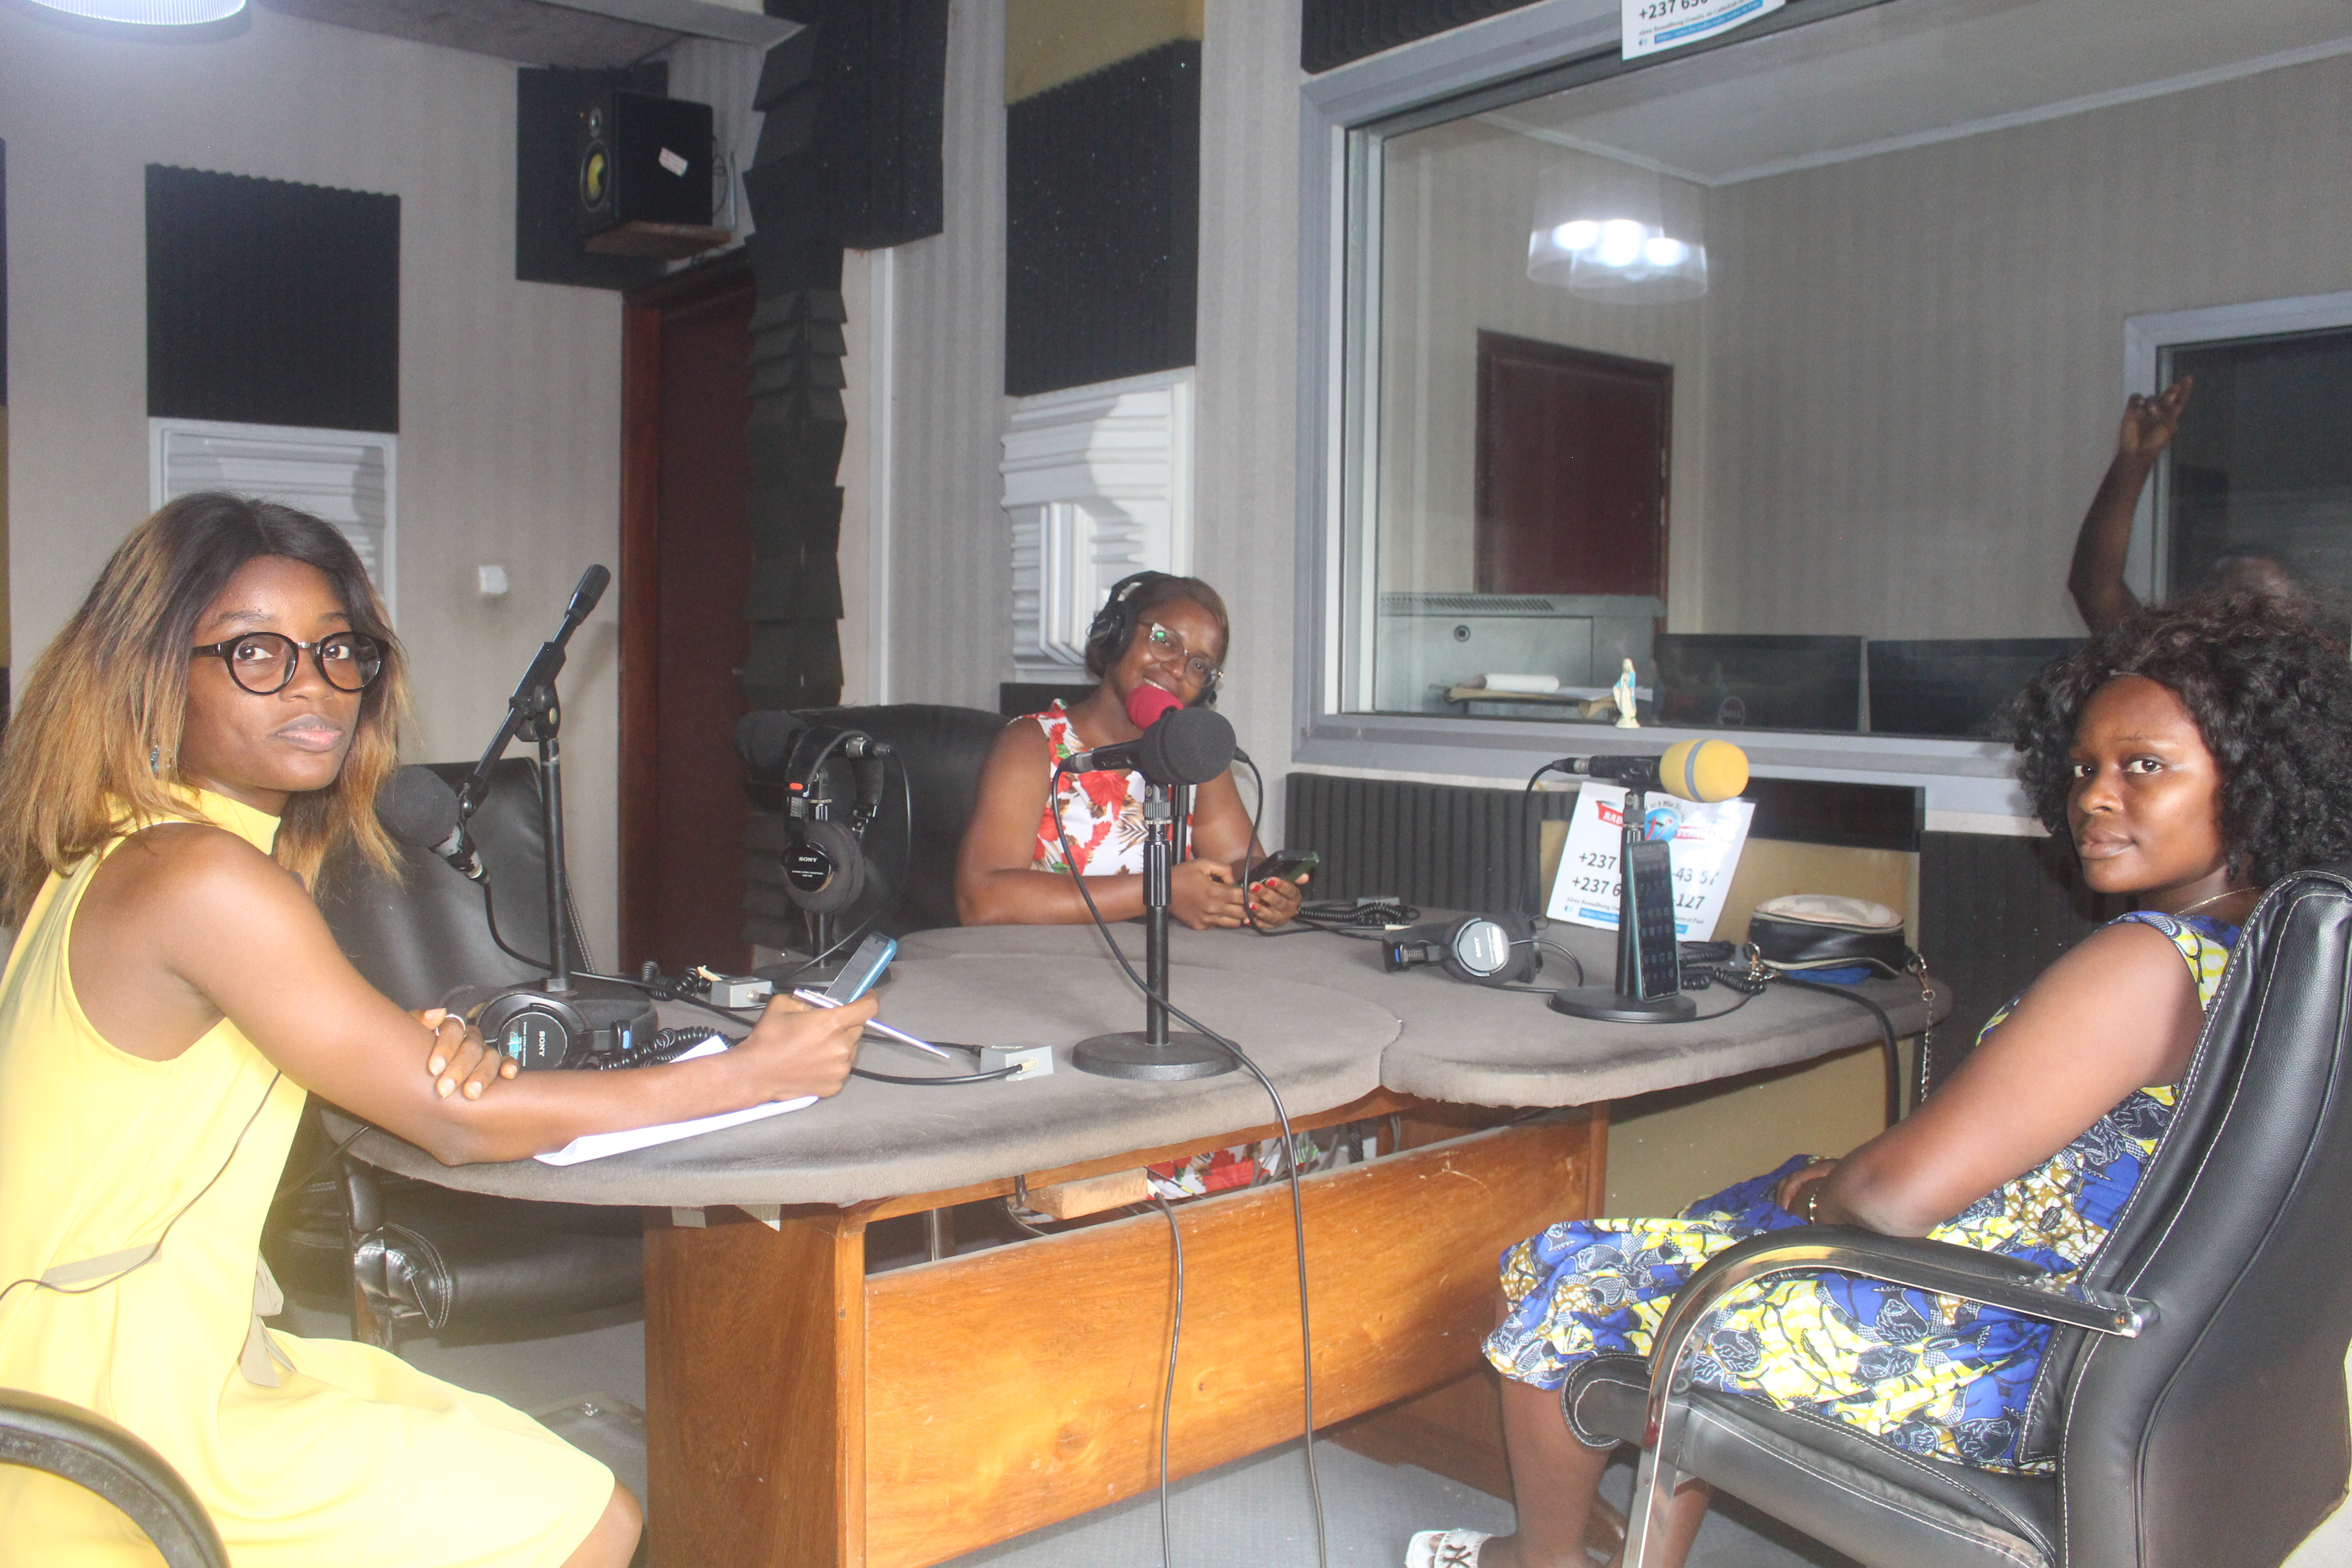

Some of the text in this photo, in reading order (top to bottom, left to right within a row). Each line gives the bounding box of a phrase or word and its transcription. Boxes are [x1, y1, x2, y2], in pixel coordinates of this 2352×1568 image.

[1602, 811, 1623, 825] RAD
[1579, 853, 1617, 870] +237
[1572, 877, 1610, 894] +237
[1474, 937, 1482, 958] SONY
